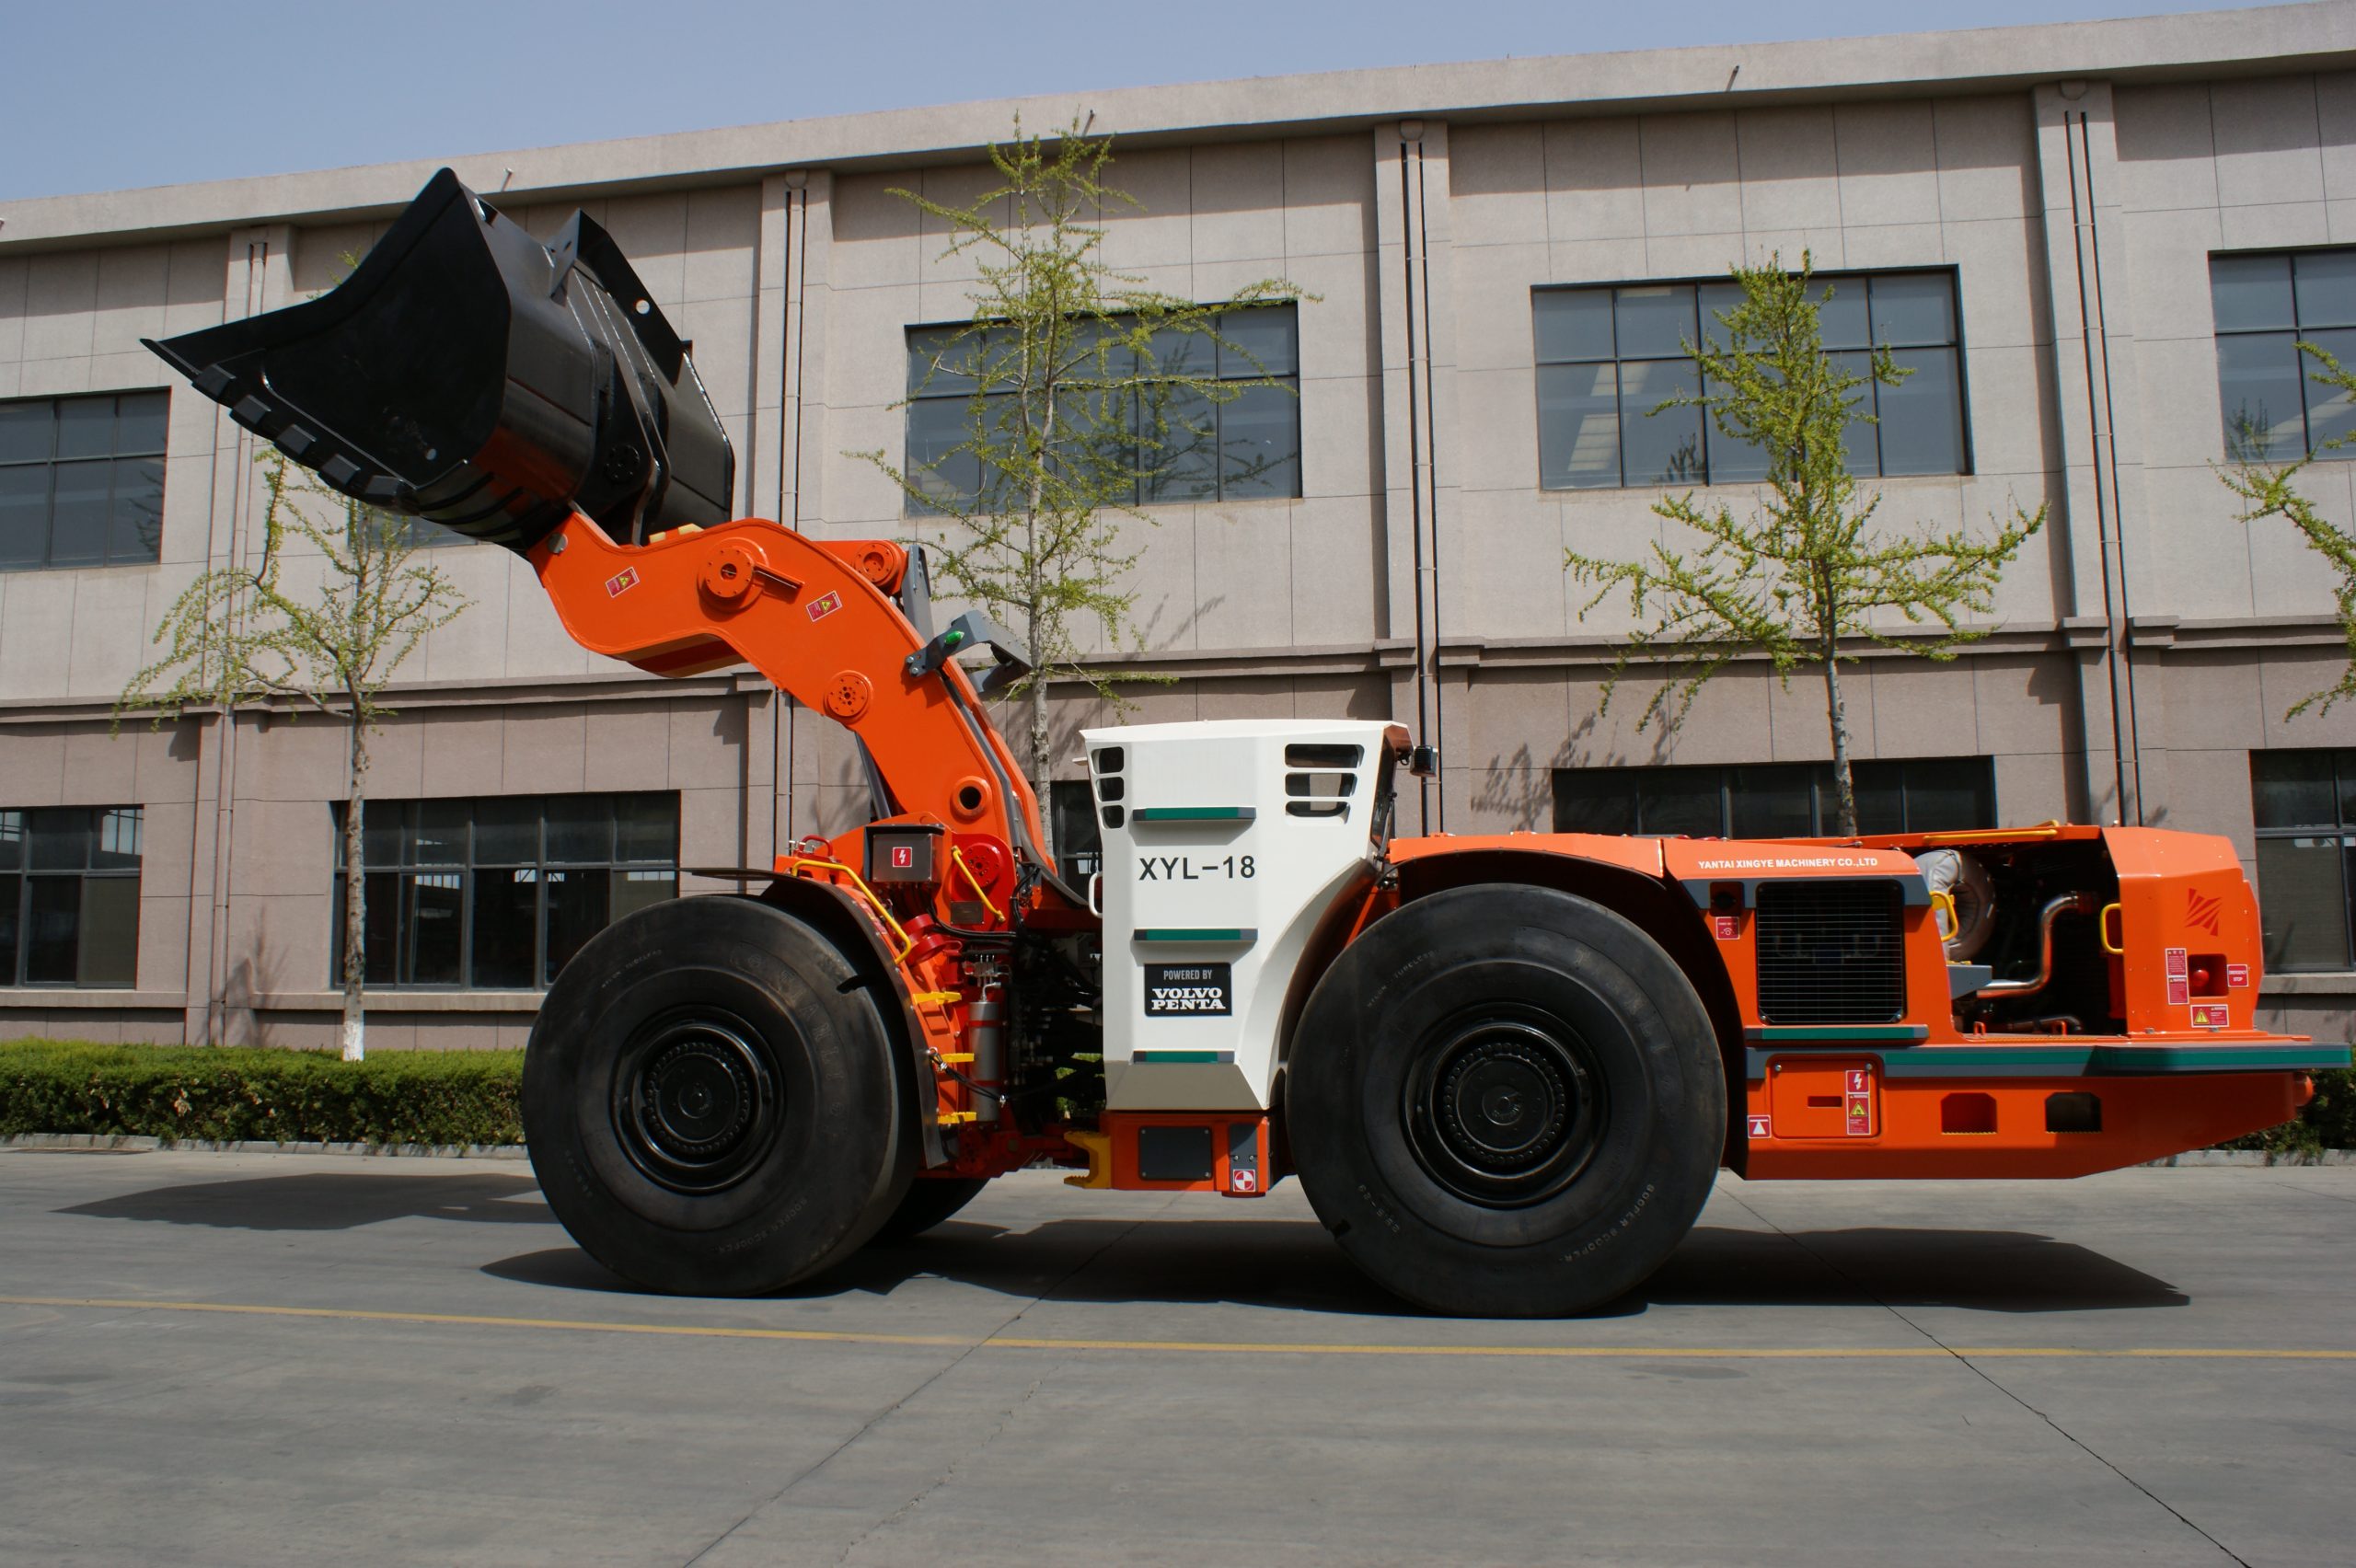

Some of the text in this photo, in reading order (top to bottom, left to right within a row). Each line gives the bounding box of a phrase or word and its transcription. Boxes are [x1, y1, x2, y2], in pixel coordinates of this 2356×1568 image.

[1138, 855, 1256, 882] XYL-18
[1698, 859, 1735, 870] YANTAI
[1736, 859, 1774, 869] XINGYE
[1775, 858, 1835, 868] MACHINERY
[1163, 969, 1213, 981] POWERED BY
[1151, 987, 1223, 999] VOLVO
[1150, 998, 1227, 1010] PENTA
